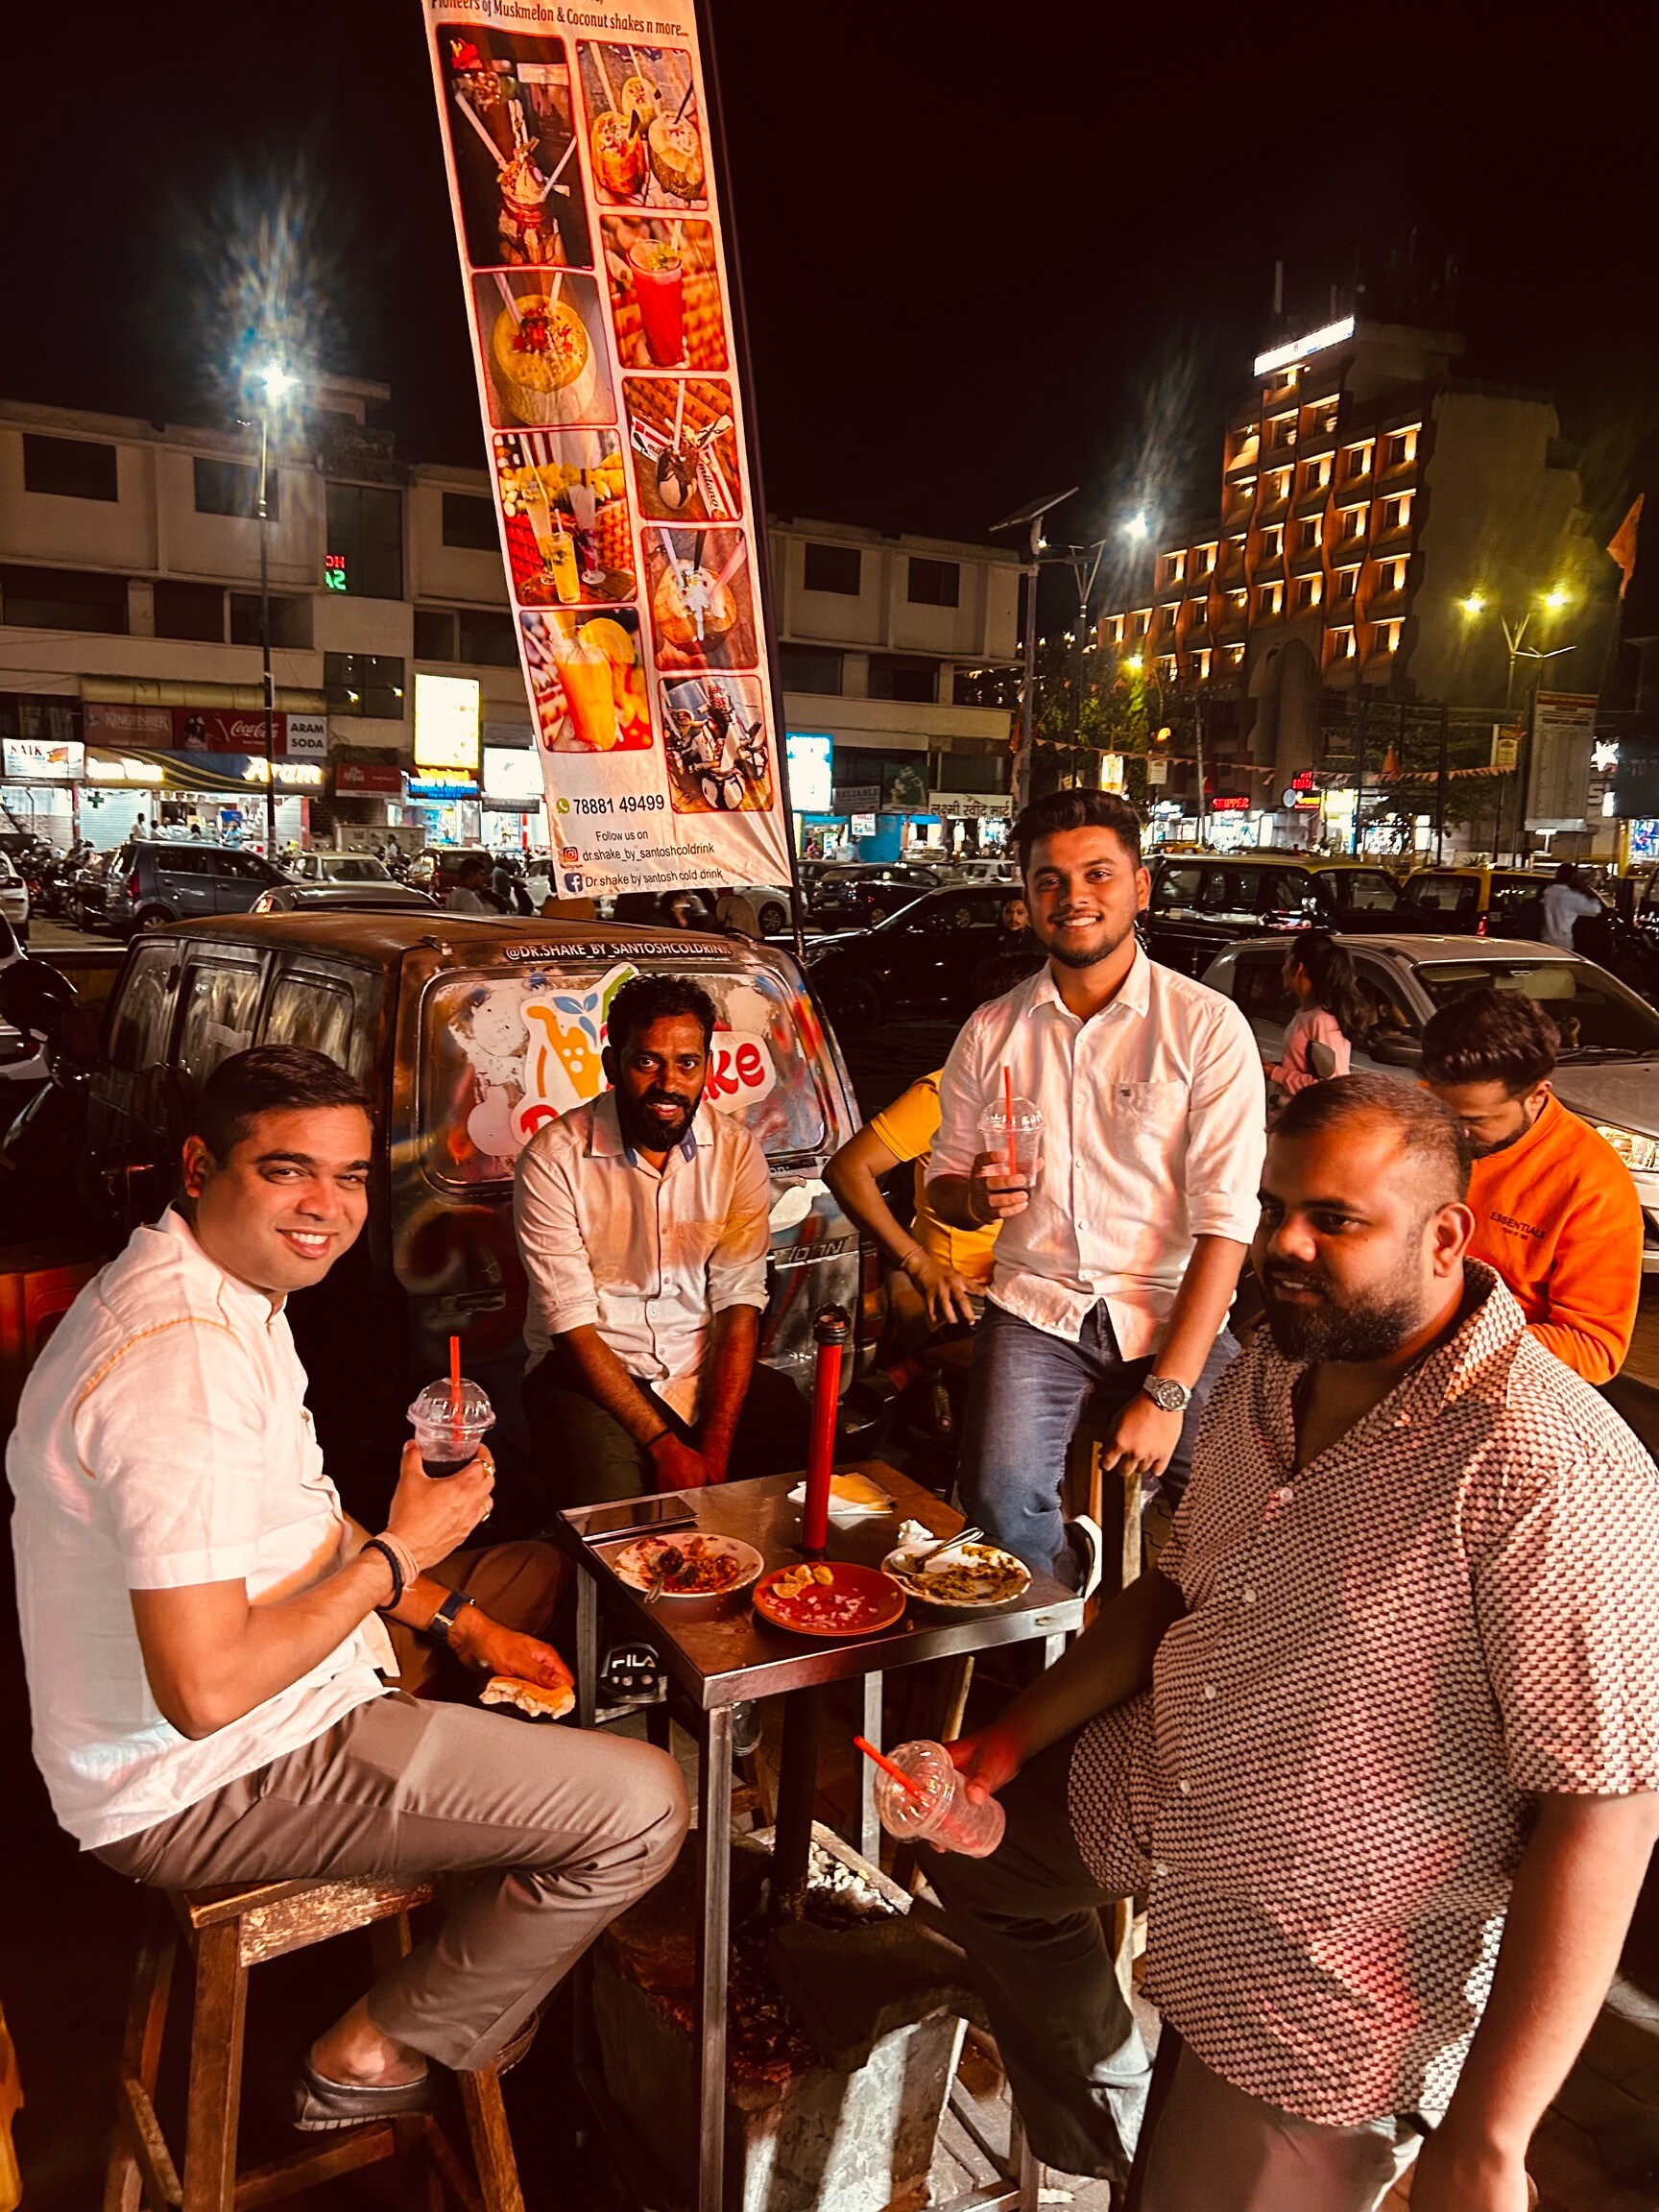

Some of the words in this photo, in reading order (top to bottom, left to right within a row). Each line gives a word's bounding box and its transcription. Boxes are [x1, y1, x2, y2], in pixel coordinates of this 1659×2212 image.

[493, 0, 555, 21] Muskmelon
[557, 7, 565, 22] &
[566, 9, 609, 28] Coconut
[610, 13, 644, 32] shakes
[646, 20, 654, 33] n
[698, 463, 719, 508] milano
[291, 723, 325, 733] ARAM
[291, 738, 325, 749] SODA
[242, 756, 323, 784] Aram
[573, 798, 614, 814] 78881
[619, 794, 665, 812] 49499
[595, 831, 623, 841] Follow
[625, 831, 635, 840] us
[637, 830, 649, 839] on
[583, 843, 715, 862] dr.shake_by_santoshcoldrink
[586, 875, 630, 887] Dr.shake
[631, 874, 641, 886] by
[643, 872, 678, 883] santosh
[679, 870, 698, 880] cold
[700, 868, 724, 879] drink
[1490, 1212, 1546, 1239] ESSENTIALS
[612, 1654, 656, 1669] FILA
